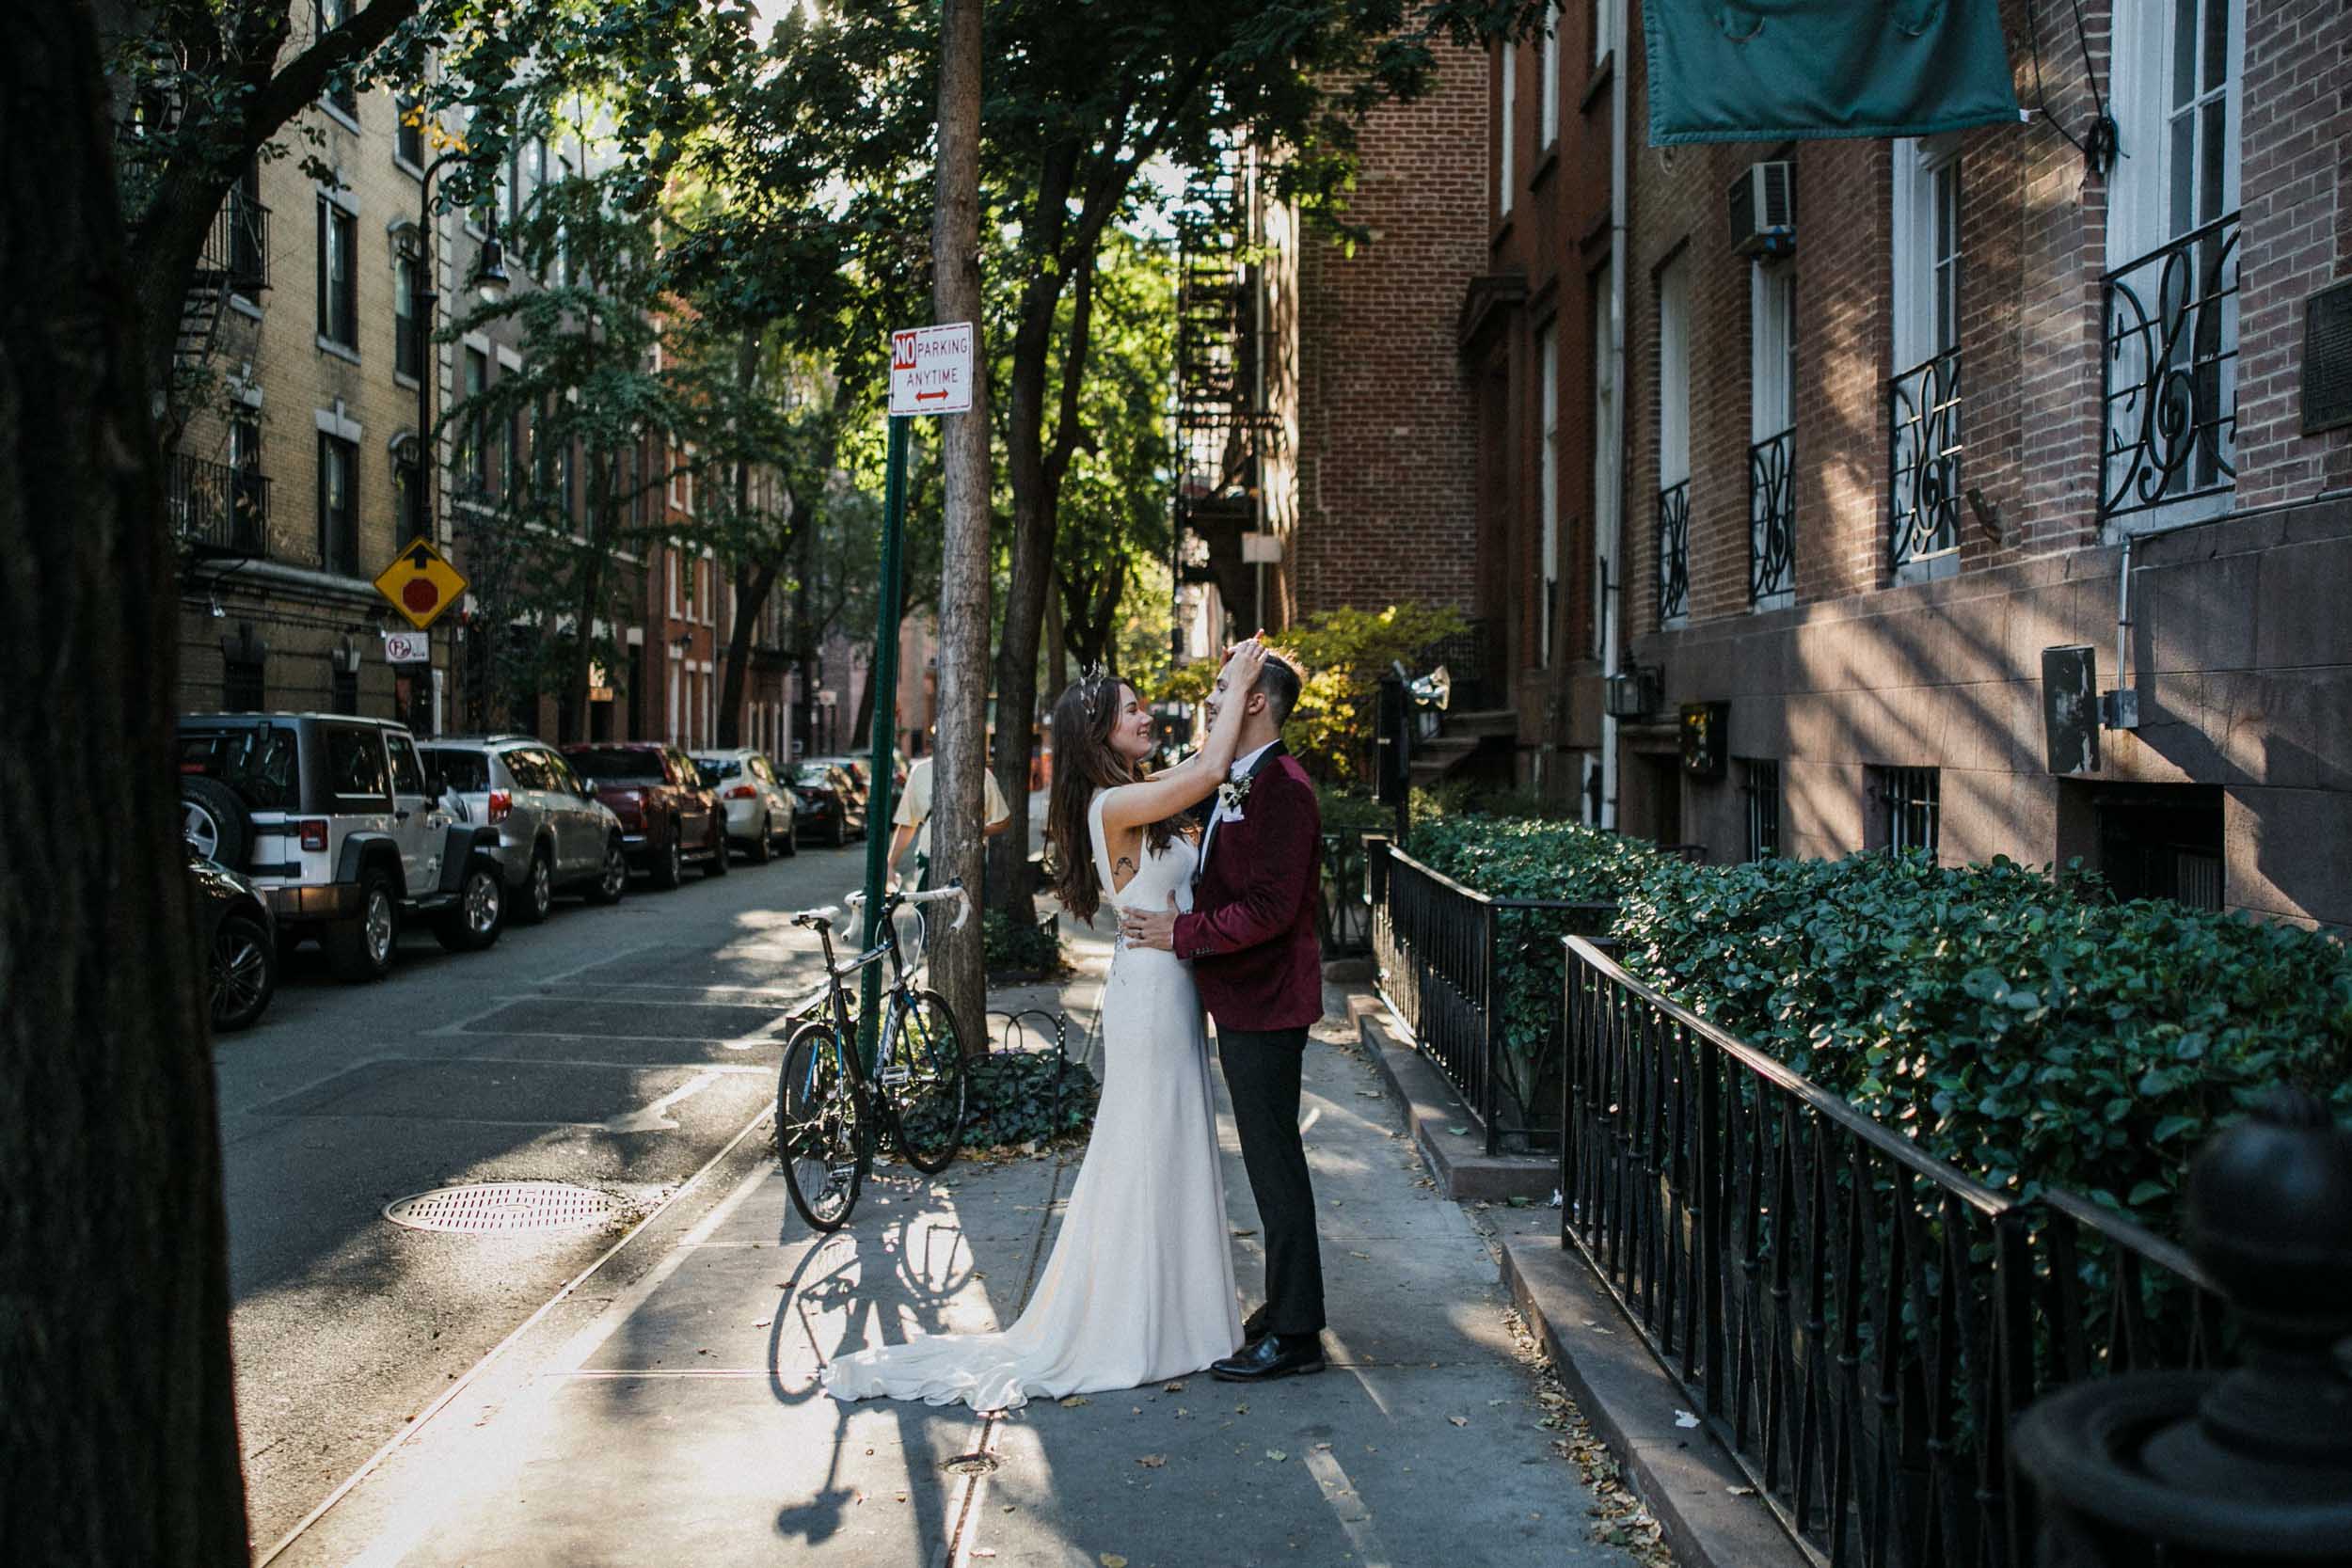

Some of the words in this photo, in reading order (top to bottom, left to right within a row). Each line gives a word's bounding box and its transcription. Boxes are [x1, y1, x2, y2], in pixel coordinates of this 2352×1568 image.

[895, 337, 915, 365] NO
[917, 339, 967, 356] PARKING
[906, 368, 958, 387] ANYTIME
